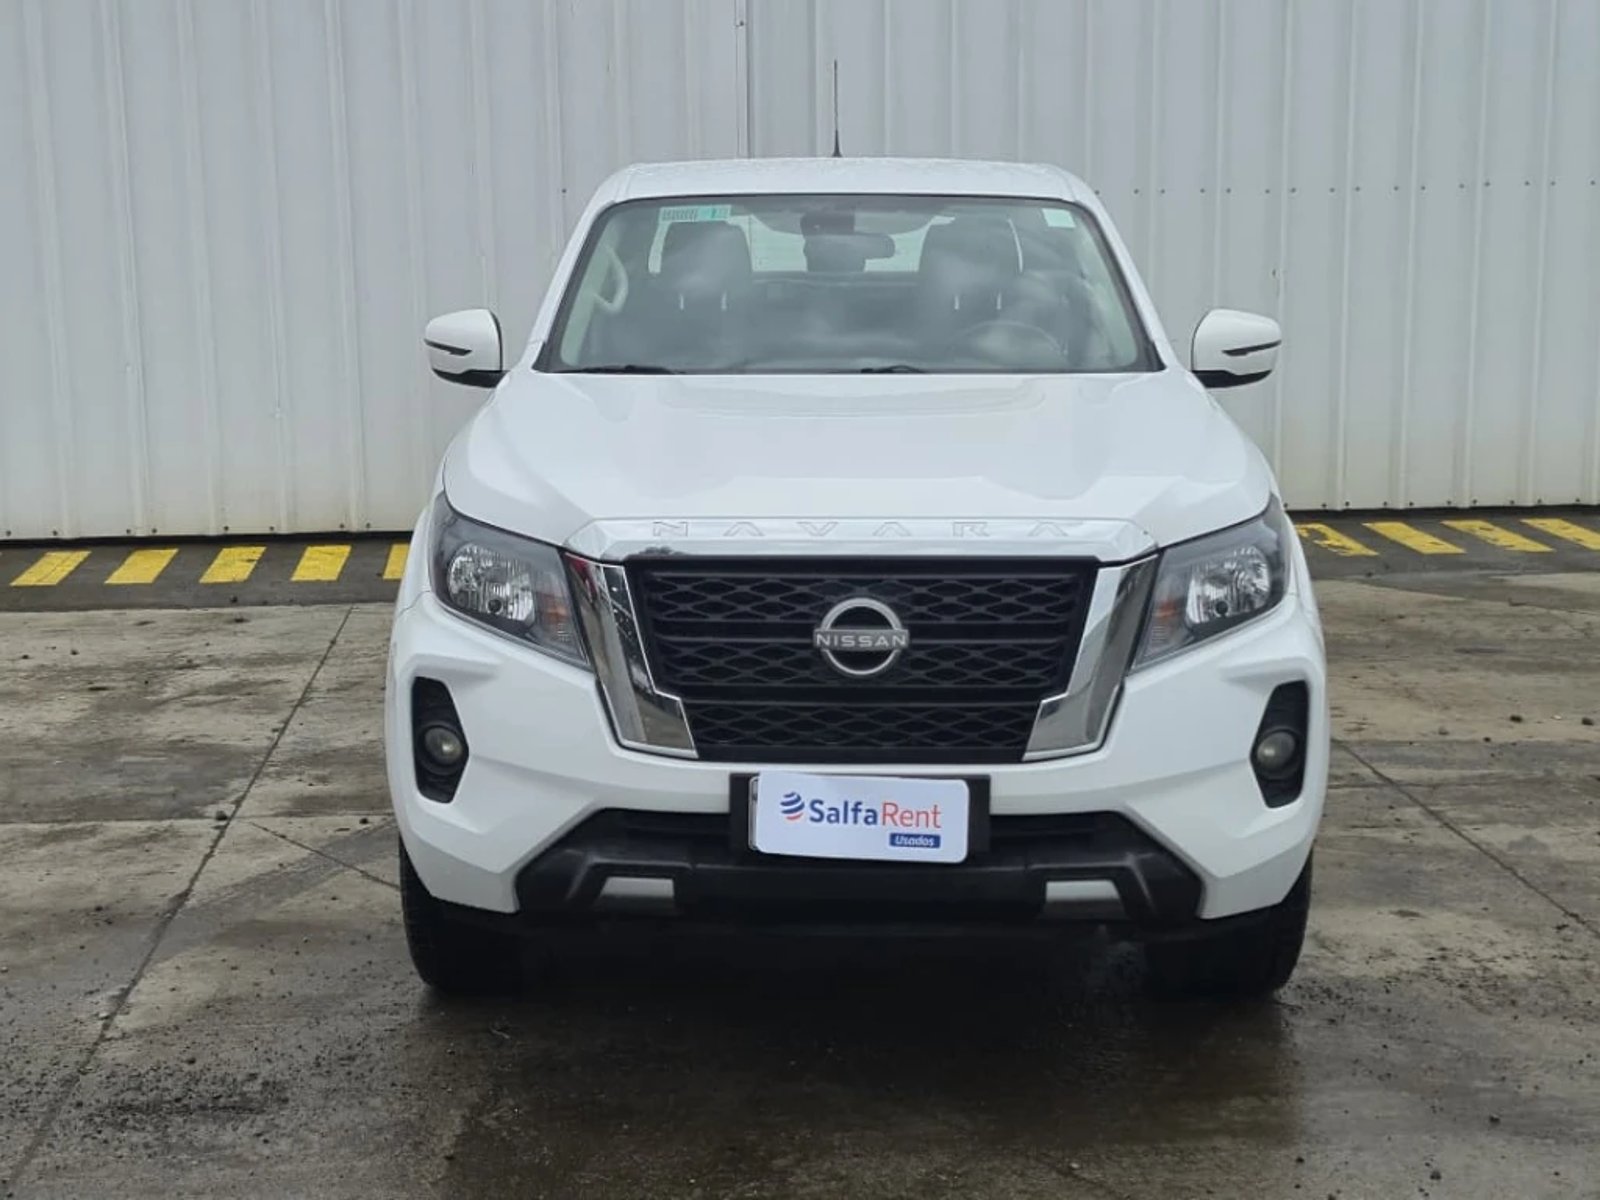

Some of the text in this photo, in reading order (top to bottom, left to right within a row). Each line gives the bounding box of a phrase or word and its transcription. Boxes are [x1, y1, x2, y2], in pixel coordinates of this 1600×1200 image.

[652, 521, 1069, 538] NAVARA
[816, 633, 906, 648] NISSAN
[894, 835, 935, 847] Usados
